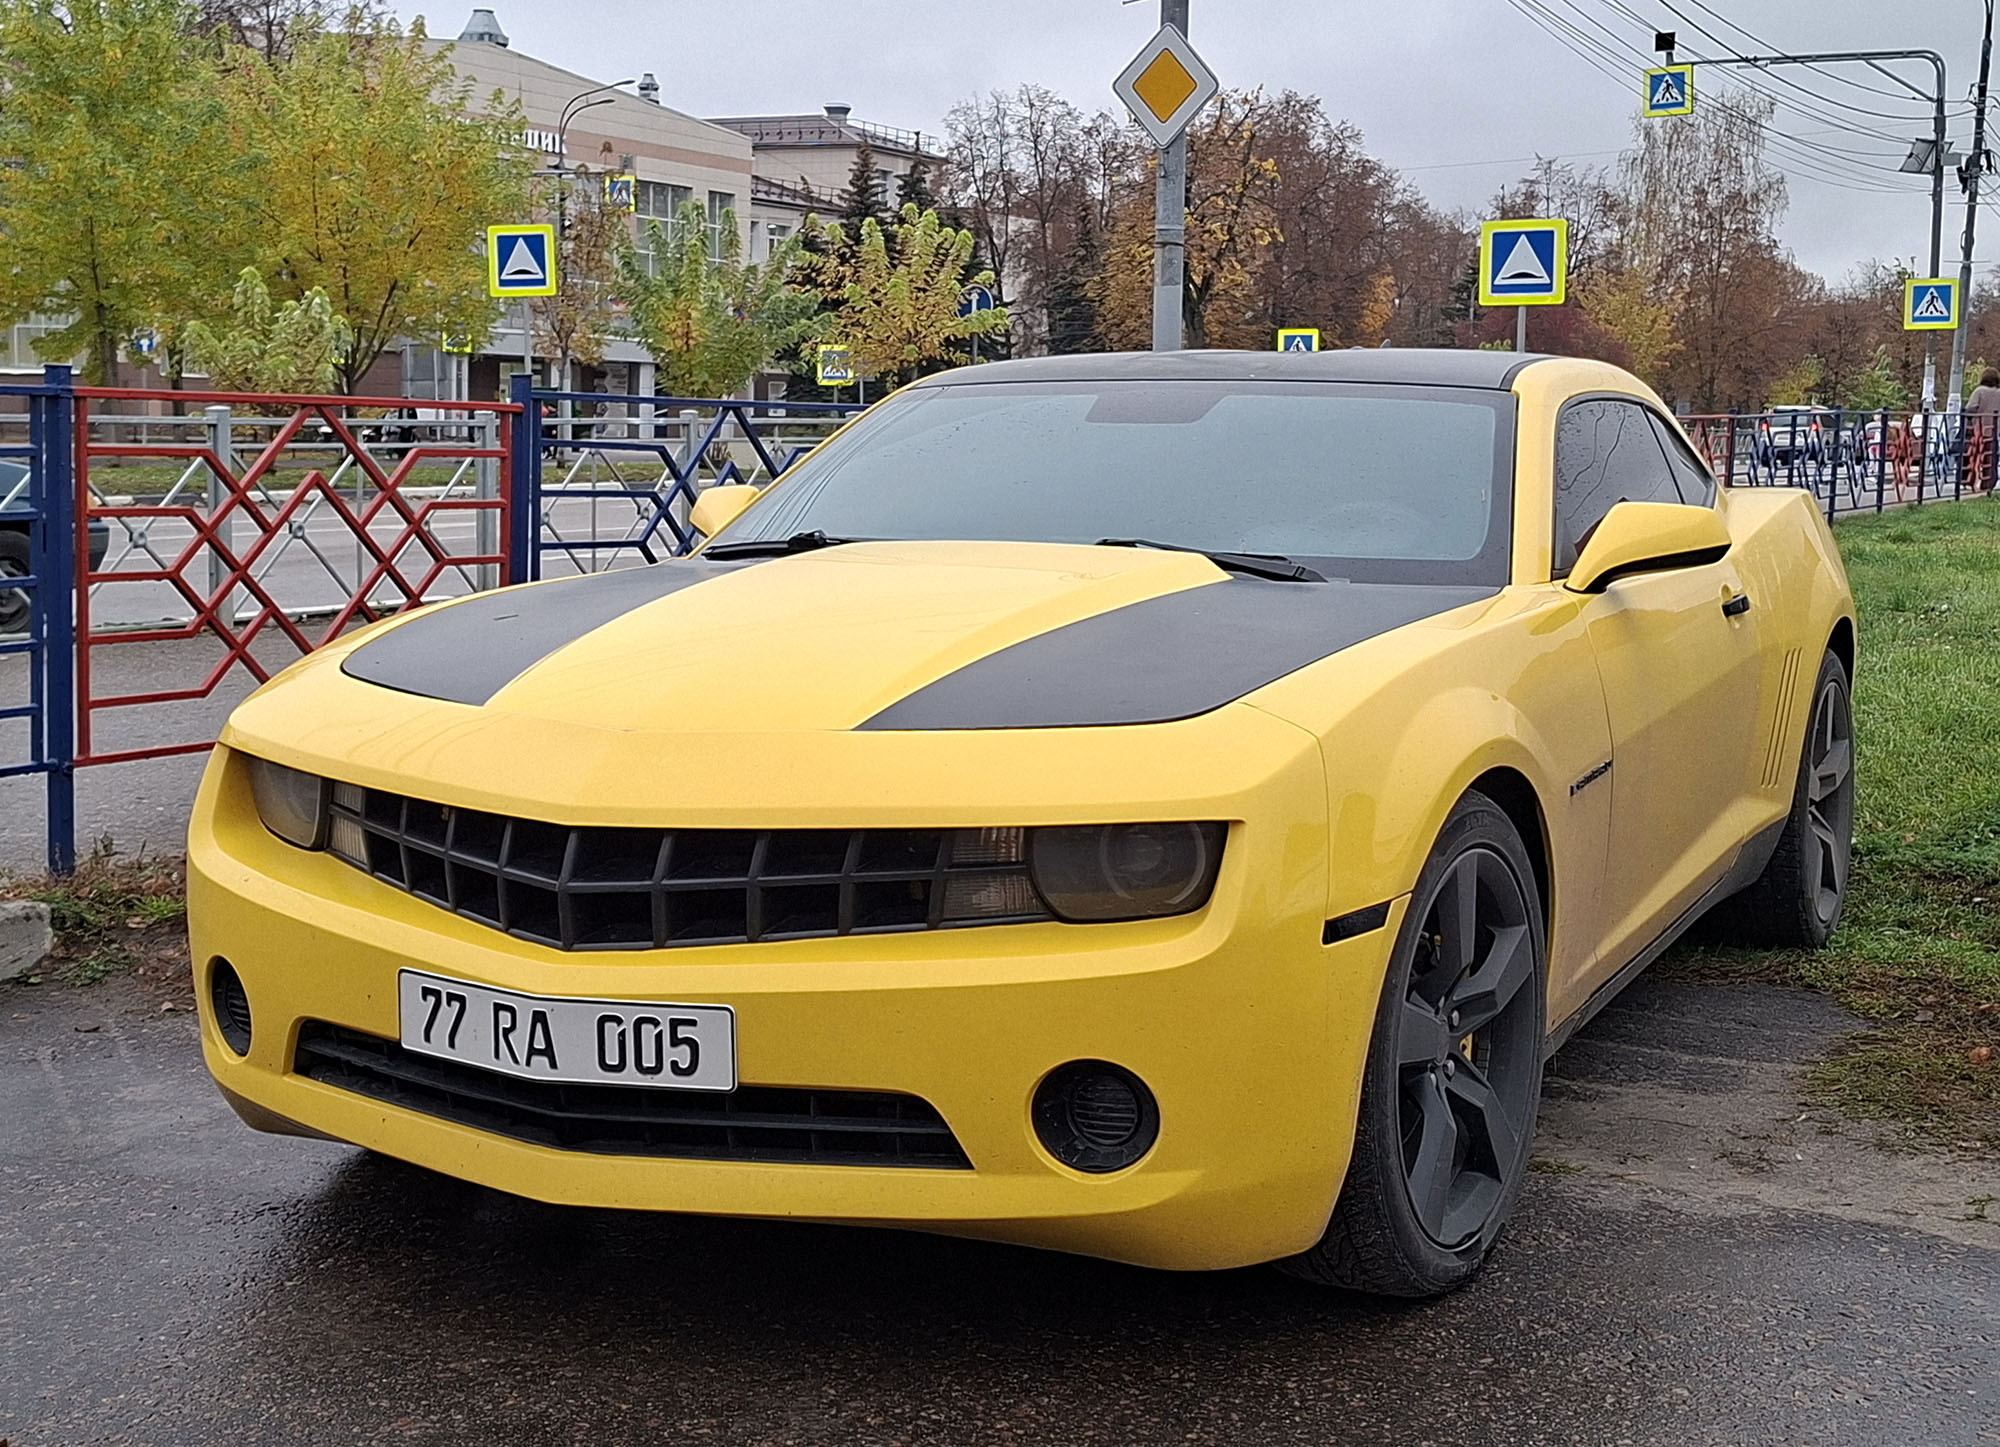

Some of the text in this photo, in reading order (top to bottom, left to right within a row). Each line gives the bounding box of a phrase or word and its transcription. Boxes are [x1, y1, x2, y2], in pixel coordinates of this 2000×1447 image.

[421, 985, 701, 1077] 77 RA 005
